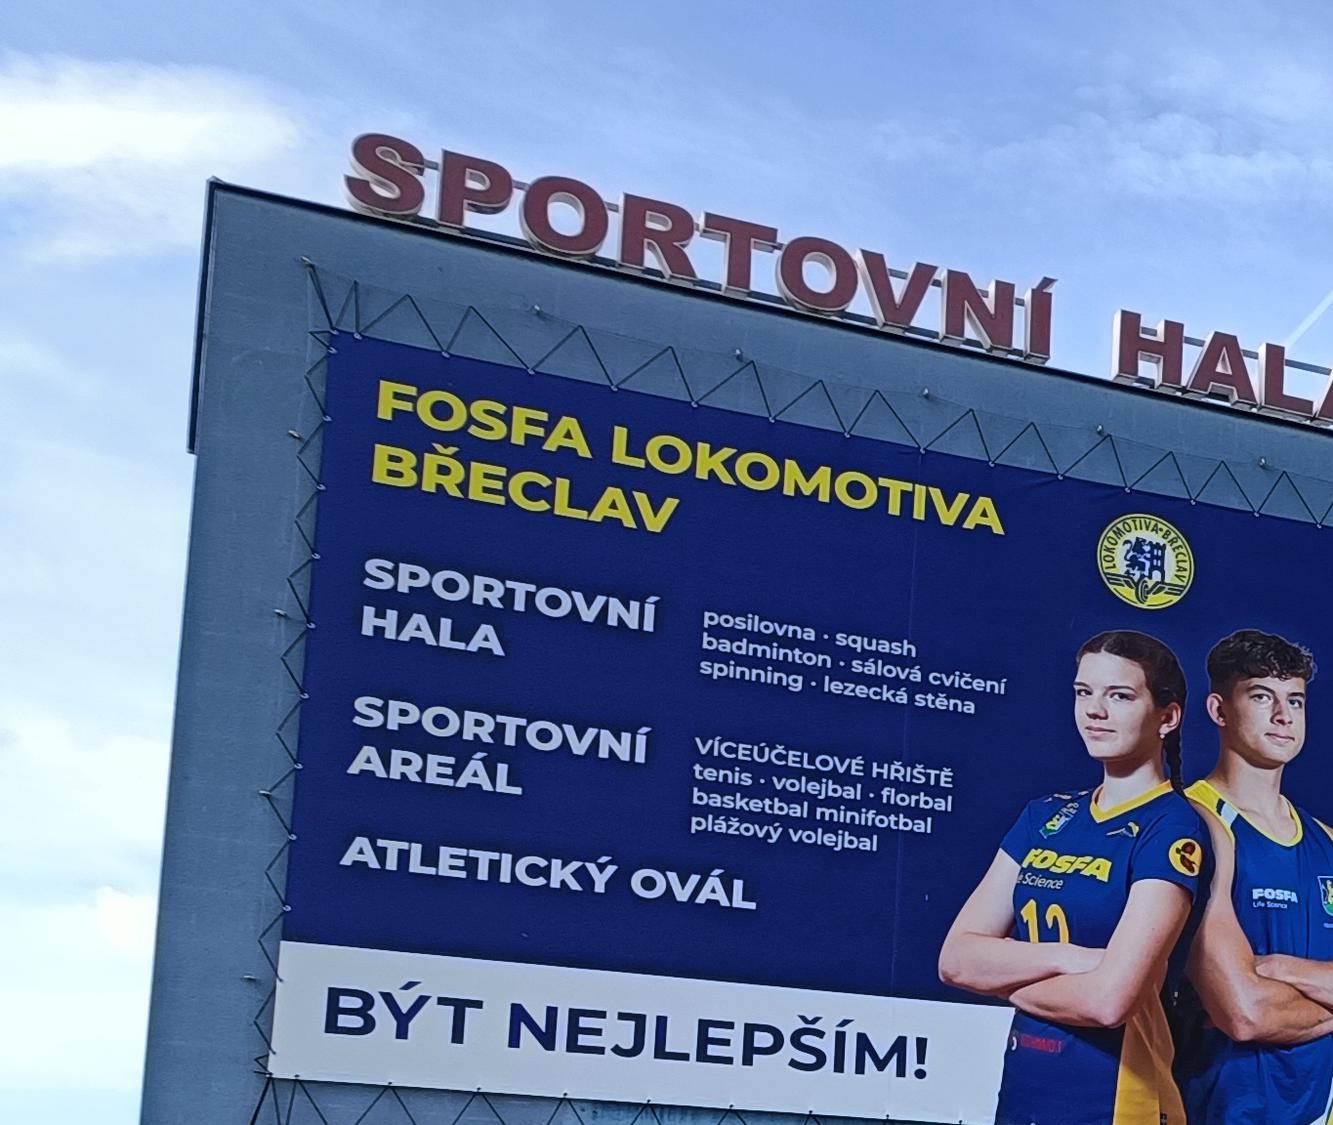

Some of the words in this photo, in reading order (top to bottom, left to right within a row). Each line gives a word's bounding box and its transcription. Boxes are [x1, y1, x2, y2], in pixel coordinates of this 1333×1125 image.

[343, 132, 1058, 364] SPORTOVNÍ
[377, 379, 592, 458] FOSFA
[612, 425, 1005, 535] LOKOMOTIVA
[371, 443, 680, 532] BŘECLAV
[1103, 519, 1159, 570] LOKOMOTIVA
[363, 558, 661, 632] SPORTOVNÍ
[361, 605, 505, 656] HALA
[703, 611, 816, 641] posilovna
[835, 631, 917, 658] squash
[700, 659, 803, 692] spinning
[823, 675, 908, 704] lezecká
[914, 691, 976, 714] stěna
[702, 632, 832, 668] badminton
[851, 658, 922, 683] sálová
[928, 672, 1007, 695] cvičení
[352, 695, 652, 764] SPORTOVNÍ
[347, 745, 523, 795] AREÁL
[693, 763, 753, 786] tenis
[772, 775, 862, 801] volejbal
[881, 787, 953, 812] florbal
[694, 736, 865, 776] VÍCEÚČELOVÉ
[871, 761, 954, 788] HŘIŠTĚ
[690, 814, 783, 844] plážový
[788, 828, 878, 852] volejbal
[692, 787, 808, 818] basketbal
[815, 804, 932, 834] minifotbal
[340, 836, 618, 894] ATLETICKÝ
[630, 868, 757, 910] OVÁL
[1022, 848, 1112, 882] FOSFA
[1022, 872, 1063, 890] Science
[1252, 888, 1298, 904] FOSFA
[323, 980, 484, 1045] BÝT
[507, 1002, 929, 1080] NEJLEPŠÍM!
